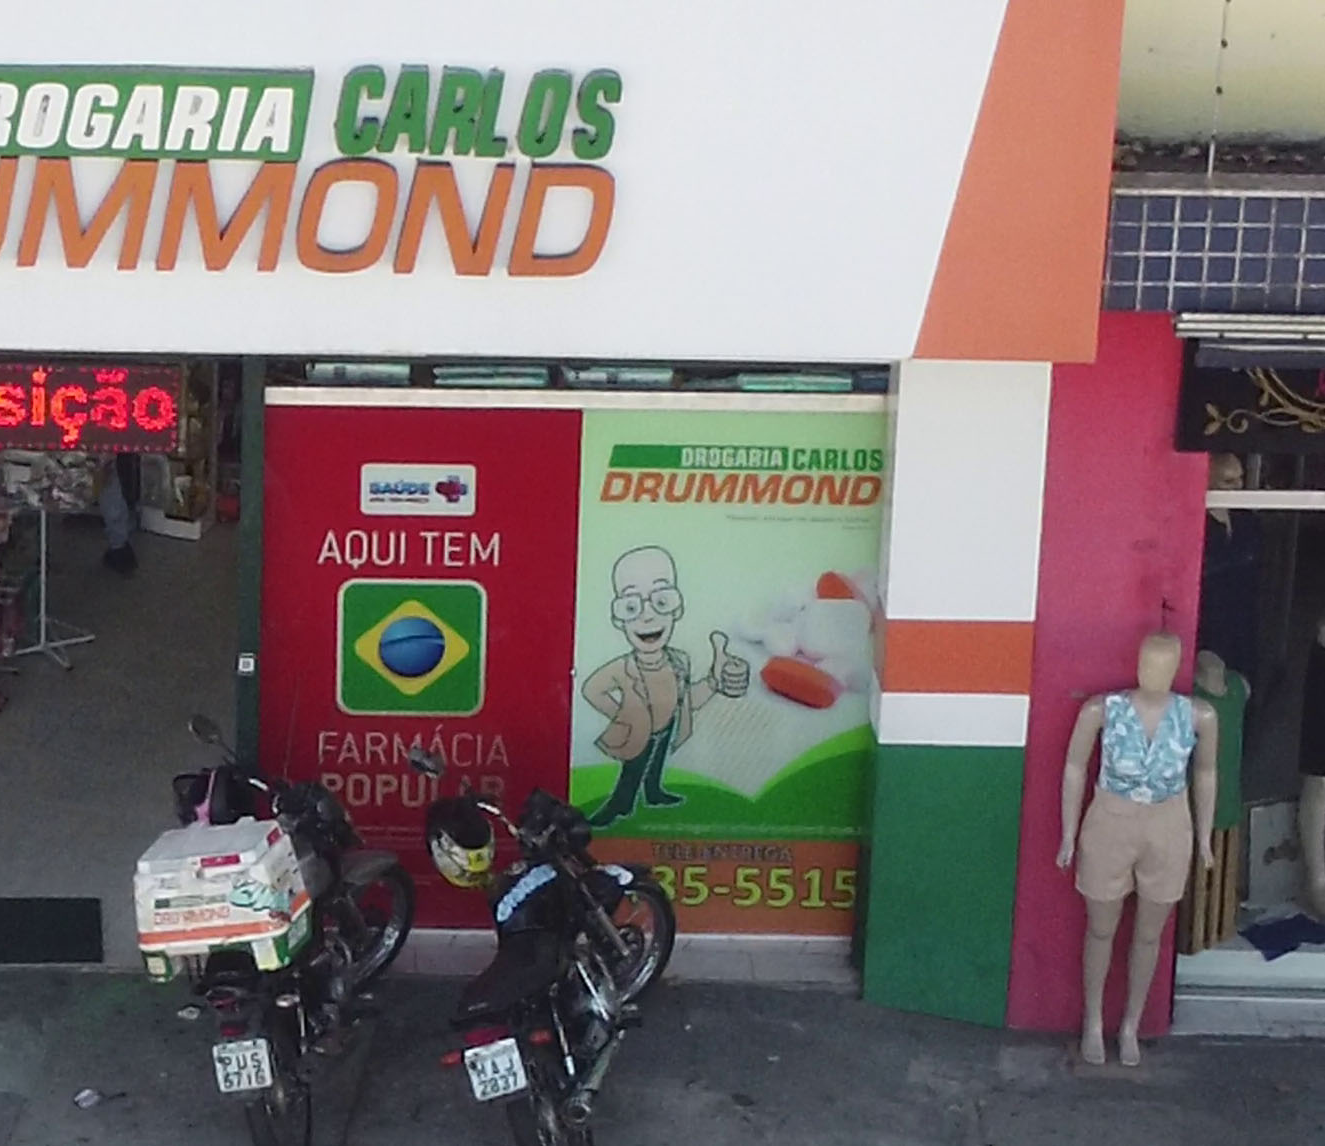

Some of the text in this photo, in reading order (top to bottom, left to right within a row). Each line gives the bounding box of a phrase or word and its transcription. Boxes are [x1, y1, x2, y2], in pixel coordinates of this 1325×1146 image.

[333, 63, 622, 160] CARLOS
[679, 446, 884, 471] DROGARIA CARLOS
[600, 471, 882, 506] DRUMMOND
[317, 530, 500, 570] AQUI TEM
[318, 724, 509, 767] FARMÁCIA
